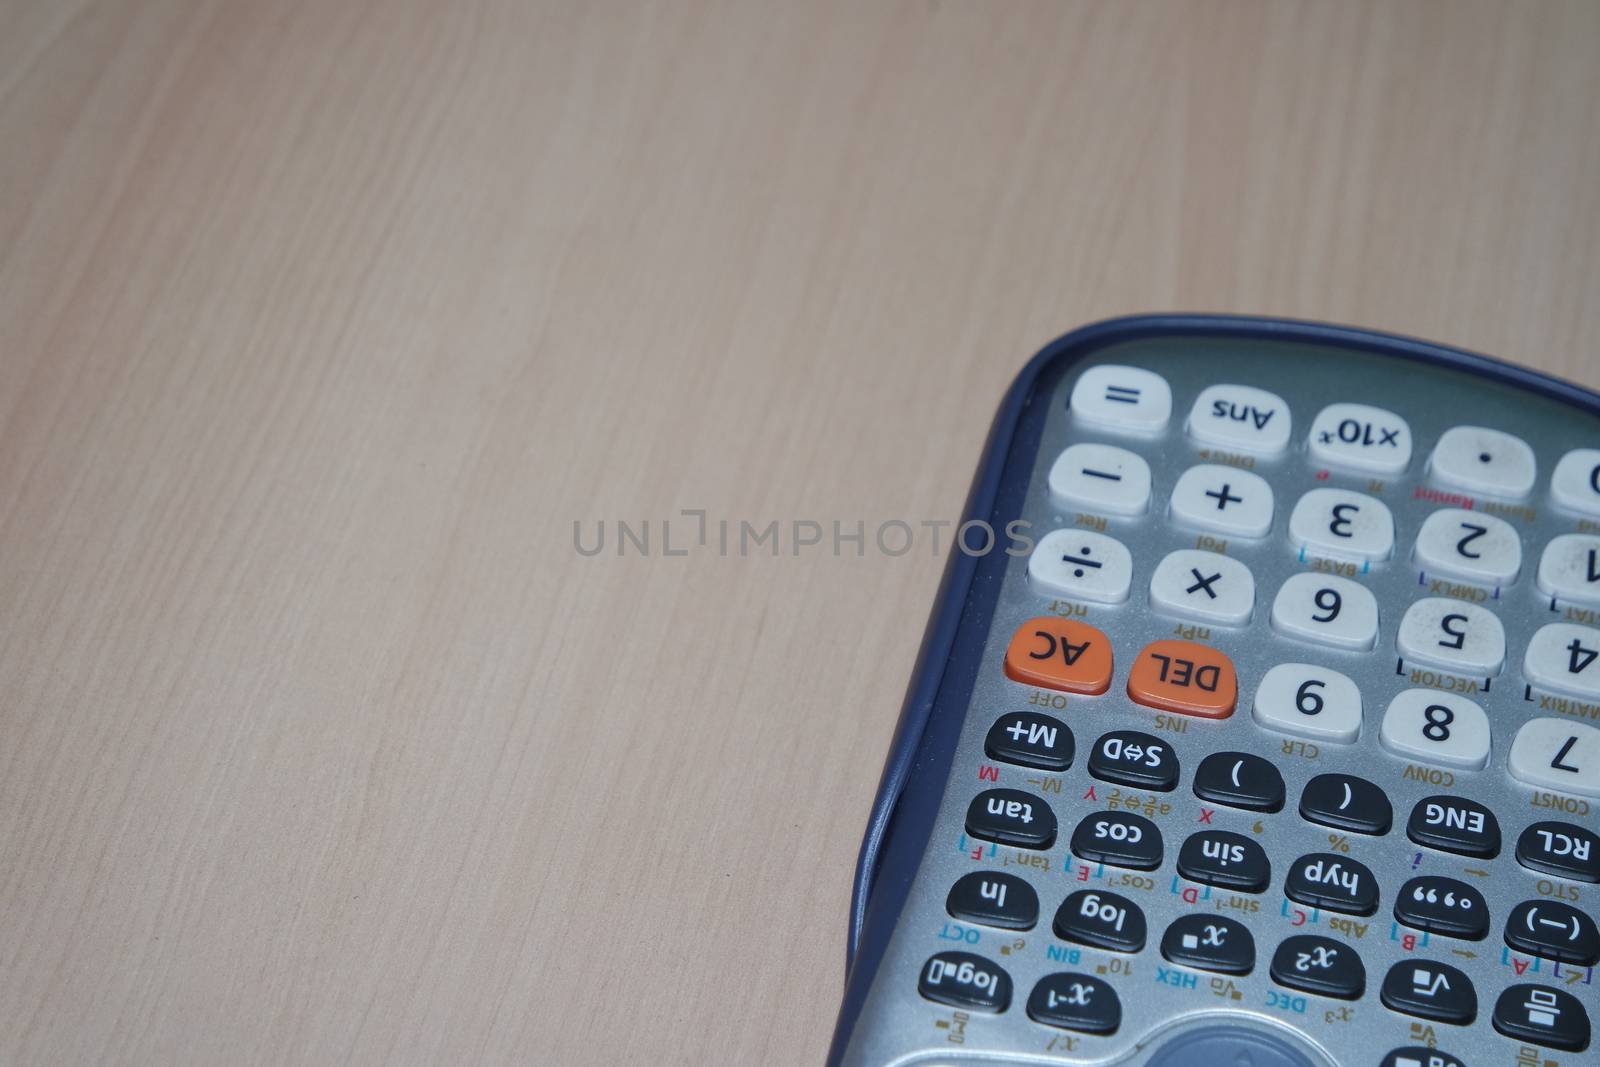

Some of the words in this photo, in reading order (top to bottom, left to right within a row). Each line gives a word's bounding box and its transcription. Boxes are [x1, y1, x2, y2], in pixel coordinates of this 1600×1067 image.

[1212, 400, 1275, 430] Ans
[1075, 514, 1107, 532] Rec
[1329, 504, 1359, 537] 3
[1196, 535, 1227, 552] Pol
[1456, 523, 1487, 559] 2
[1063, 546, 1102, 578] ÷
[1312, 559, 1357, 577] BASE
[1430, 579, 1487, 602] CMPLX
[1048, 600, 1088, 617] nCr
[1312, 588, 1342, 623] 6
[1564, 607, 1600, 623] TAT
[1173, 624, 1211, 642] nPr
[1438, 614, 1468, 649] 5
[1029, 630, 1091, 666] AC
[1567, 639, 1599, 674] 4
[1150, 653, 1221, 692] DEL
[1409, 670, 1478, 695] VECTOR
[1028, 691, 1068, 710] OFF
[1296, 680, 1326, 716] 9
[1006, 720, 1057, 748] M+
[1154, 715, 1188, 734] INS
[1422, 704, 1454, 742] 8
[1280, 740, 1319, 760] CLR
[1550, 736, 1579, 774] 7
[978, 766, 999, 782] M
[1231, 760, 1244, 787] )
[1402, 765, 1454, 788] CONV
[1083, 786, 1097, 801] Y
[1339, 783, 1352, 809] (
[1529, 792, 1590, 816] CONST
[987, 797, 1033, 824] tan
[1198, 808, 1214, 824] X
[1425, 804, 1485, 833] ENG
[1094, 820, 1143, 845] cos
[1327, 833, 1350, 853] %
[971, 846, 984, 861] F
[1202, 840, 1245, 866] sin
[1536, 829, 1591, 860] RCL
[1077, 865, 1090, 881] E
[1303, 862, 1359, 895] hyp
[980, 881, 1008, 908] ln
[1182, 888, 1198, 904] D
[1536, 879, 1580, 902] STO
[1079, 894, 1127, 931] log
[1291, 910, 1307, 926] C
[938, 925, 981, 944] OCT
[1328, 917, 1368, 939] Abs
[1401, 934, 1417, 950] B
[1046, 944, 1081, 964] BIN
[1512, 957, 1530, 975] A
[1156, 968, 1198, 990] HEX
[1265, 991, 1307, 1013] DEC
